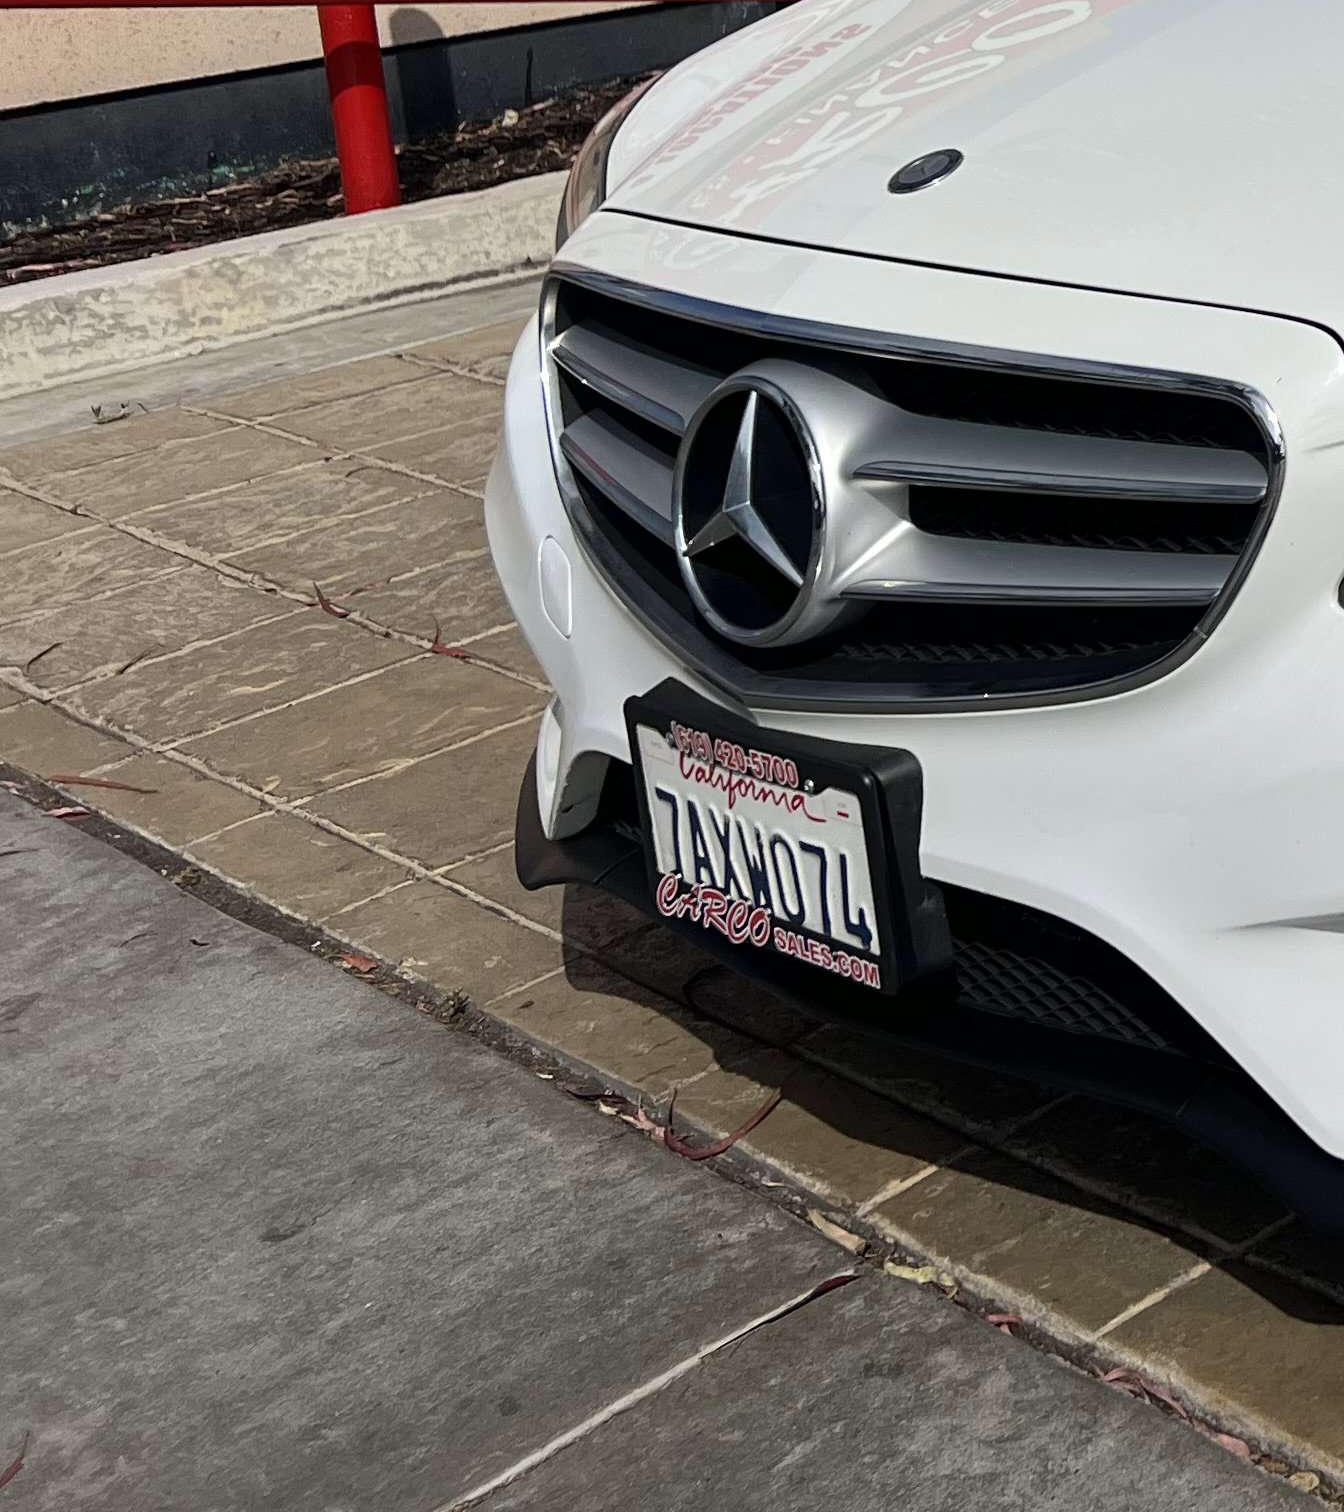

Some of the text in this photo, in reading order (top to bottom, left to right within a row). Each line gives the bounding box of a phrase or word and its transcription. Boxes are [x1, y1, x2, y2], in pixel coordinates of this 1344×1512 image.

[671, 720, 800, 790] (619) 420-5700
[679, 751, 828, 824] California
[656, 872, 881, 990] CARCO SALES.COM
